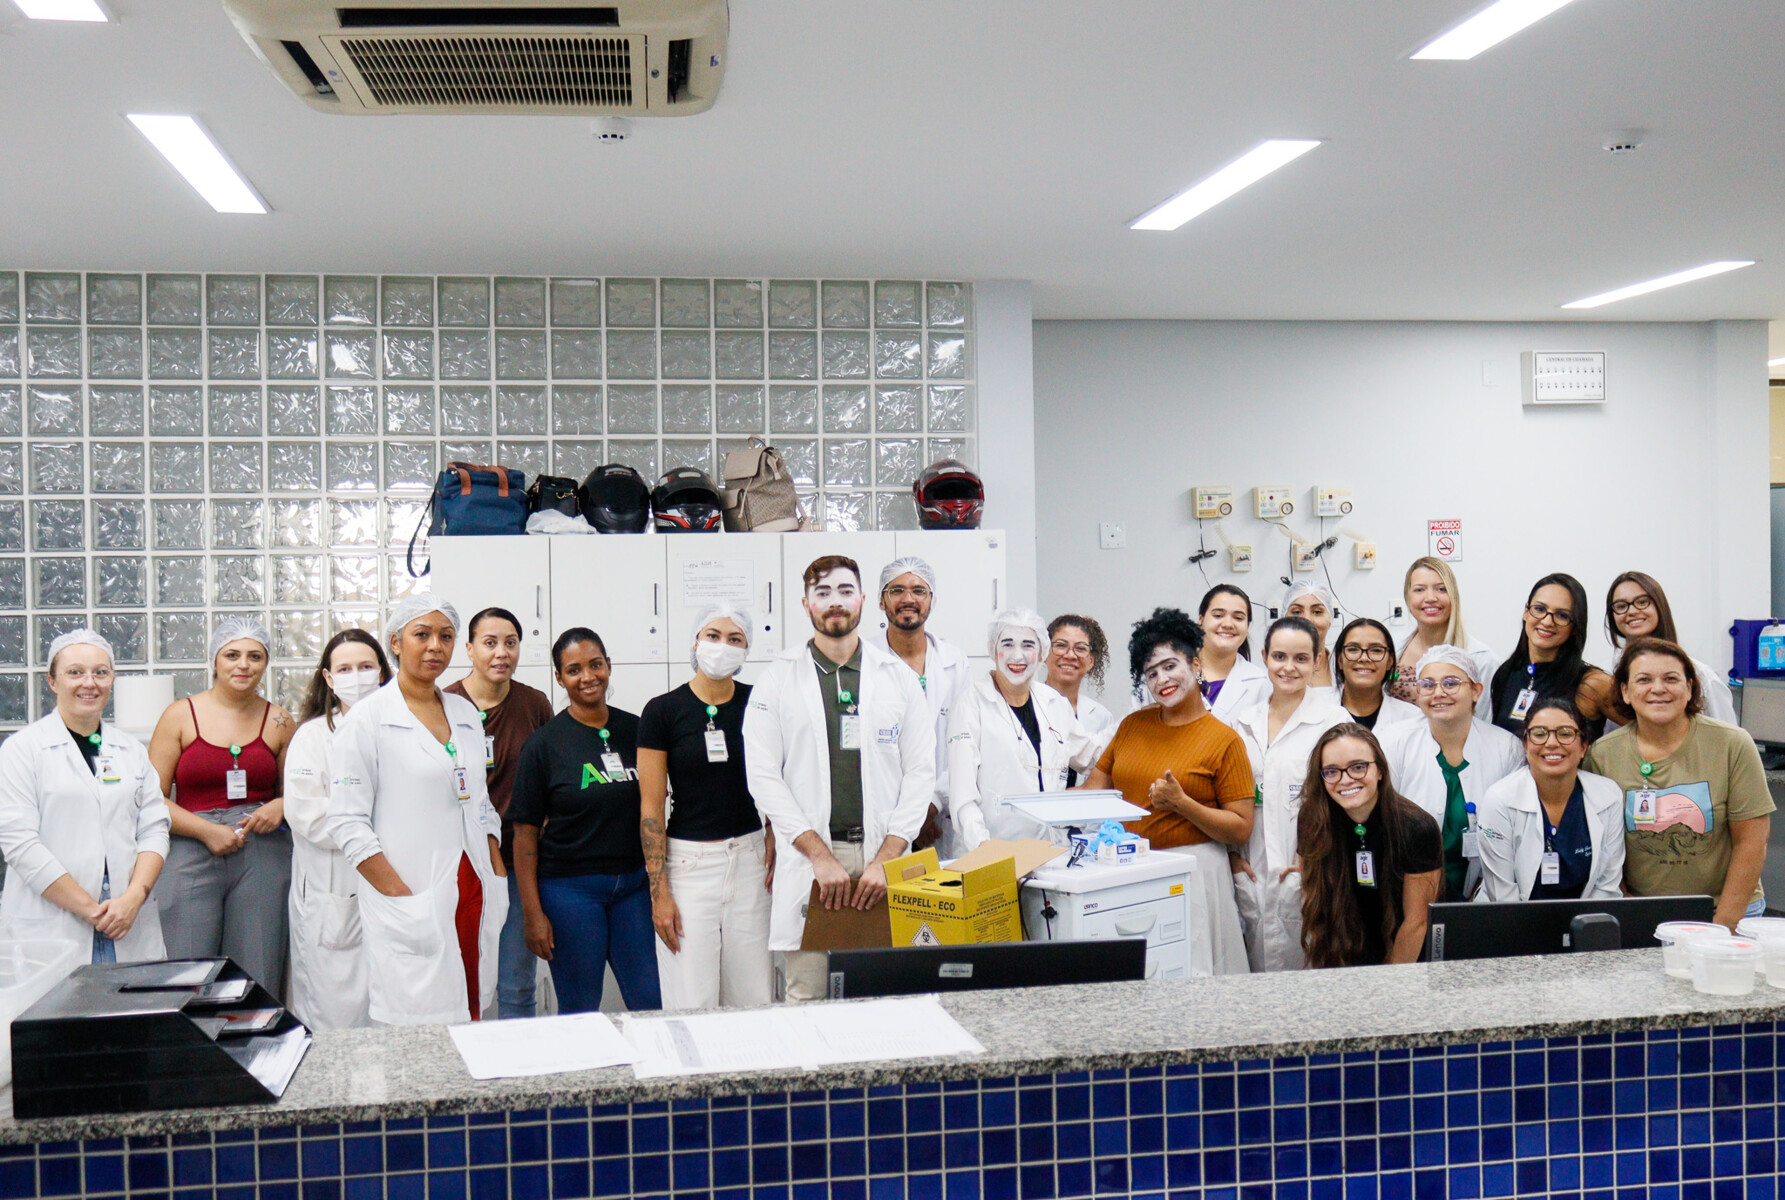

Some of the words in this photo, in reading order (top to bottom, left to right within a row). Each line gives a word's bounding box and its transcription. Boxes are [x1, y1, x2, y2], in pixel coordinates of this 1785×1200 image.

[1430, 521, 1460, 529] PROIBIDO
[892, 894, 932, 909] FLEXPELL
[938, 901, 956, 912] ECO
[1434, 927, 1442, 959] Lenovo
